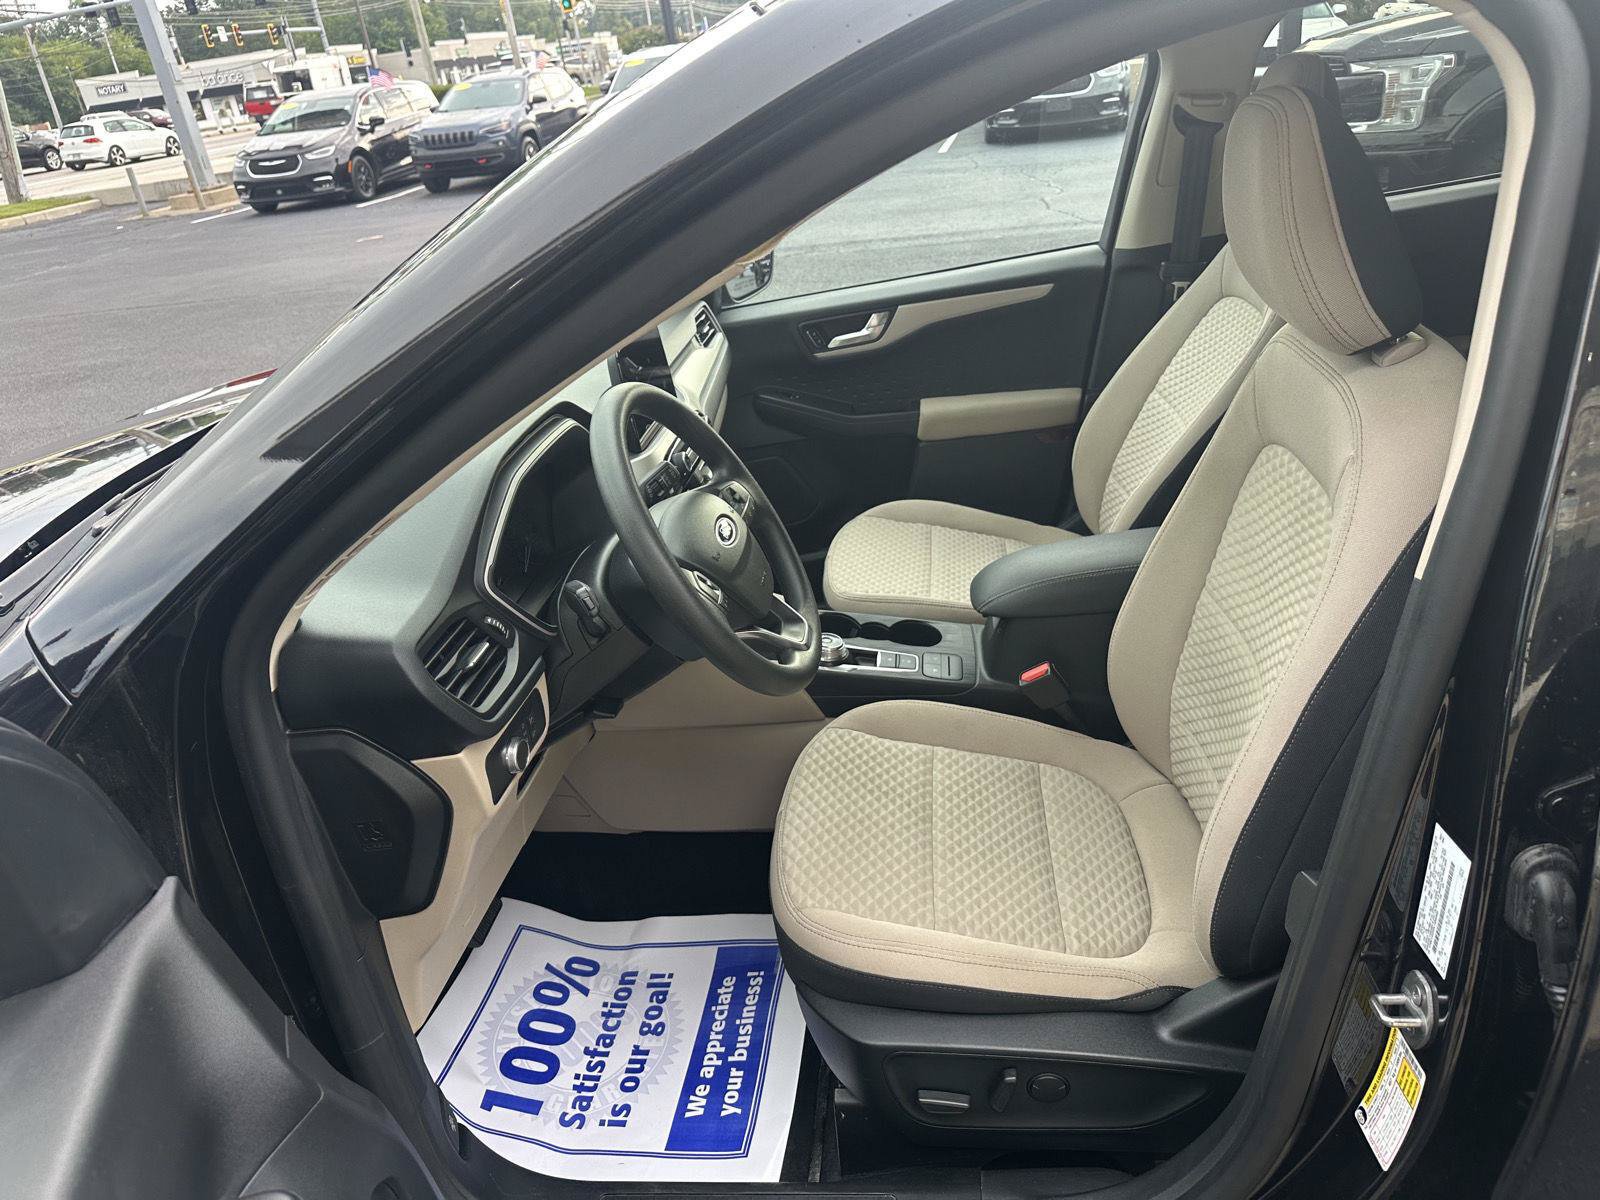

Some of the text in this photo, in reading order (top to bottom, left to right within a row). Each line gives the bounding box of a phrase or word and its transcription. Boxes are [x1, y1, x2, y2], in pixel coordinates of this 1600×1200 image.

[97, 84, 124, 95] NOTARY
[480, 956, 600, 1116] 100%
[559, 971, 638, 1129] Satisfaction
[599, 1103, 632, 1128] is
[619, 1044, 650, 1093] our
[639, 973, 674, 1037] goal!
[684, 976, 736, 1118] We appreciate
[720, 971, 764, 1117] your business!
